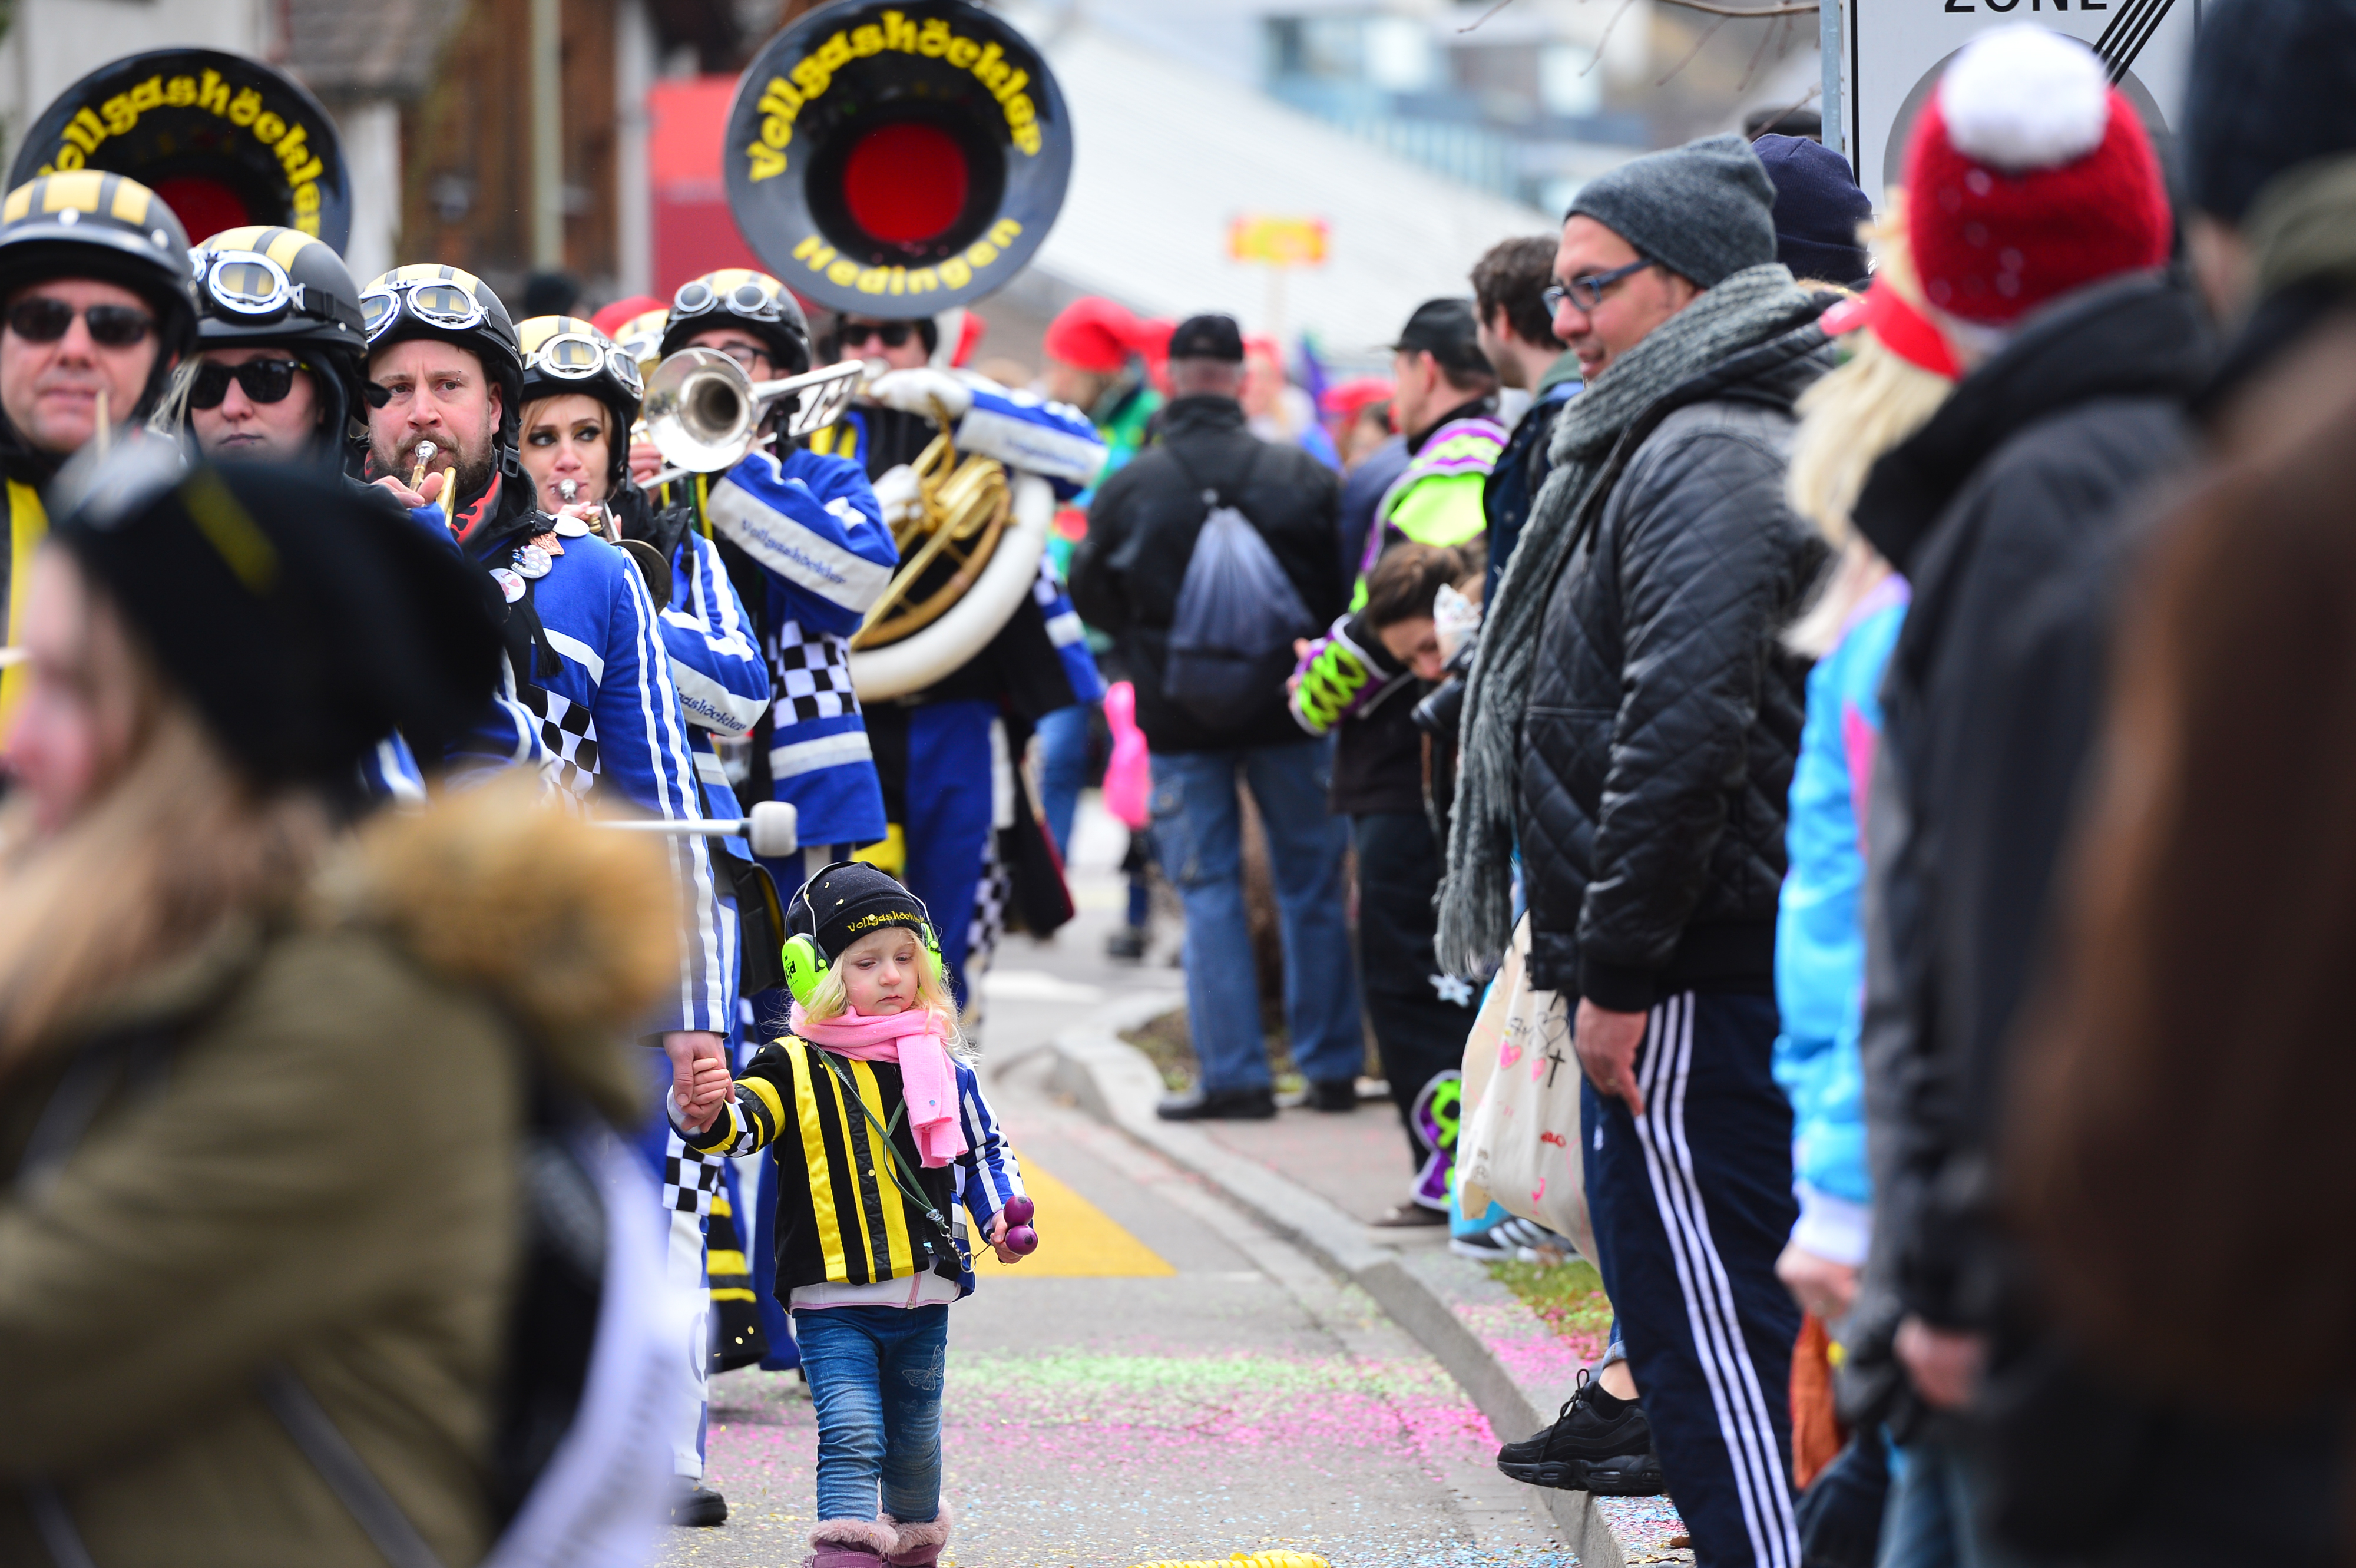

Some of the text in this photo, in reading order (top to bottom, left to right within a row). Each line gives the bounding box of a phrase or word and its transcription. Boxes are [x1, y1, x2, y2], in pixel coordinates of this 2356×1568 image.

[37, 67, 323, 238] ollgashöckler
[746, 9, 1041, 182] Vollgashöckler
[792, 218, 1023, 296] Hedingen
